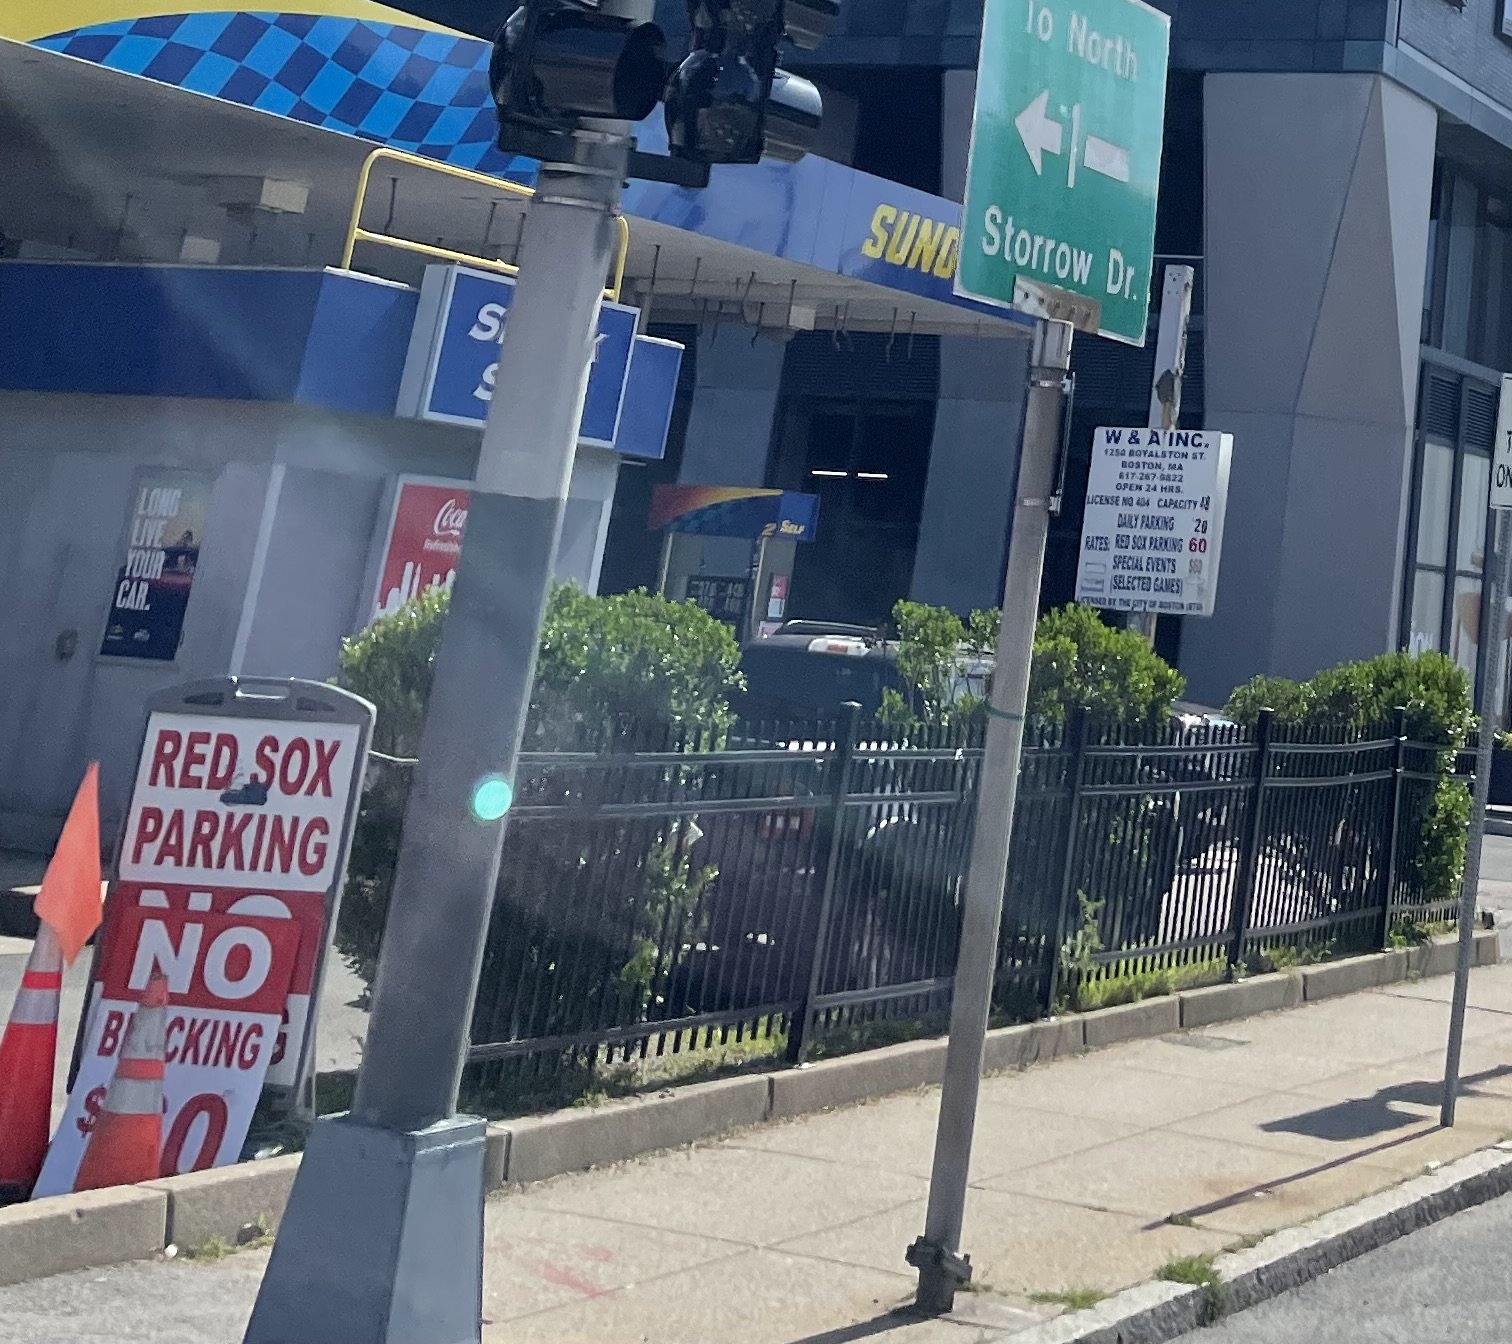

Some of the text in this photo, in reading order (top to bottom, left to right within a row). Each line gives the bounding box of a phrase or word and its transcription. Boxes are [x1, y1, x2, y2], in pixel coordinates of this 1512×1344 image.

[1067, 12, 1138, 81] North
[982, 205, 1137, 300] Storrow Dr.
[1105, 429, 1210, 449] W & A INC.
[1121, 460, 1183, 471] BOSTON, MA
[137, 487, 182, 517] LONG
[1087, 494, 1120, 506] LICENSE
[1157, 498, 1198, 510] CAPACITY
[1115, 482, 1143, 492] OPEN
[1145, 483, 1157, 493] 24
[131, 518, 168, 549] LIVE
[1117, 513, 1138, 529] DAILY
[1139, 515, 1175, 532] PARKING
[1084, 533, 1207, 553] RATES: RED SOX PARKING 60
[124, 548, 166, 580] YOUR
[1112, 554, 1144, 573] SPECIAL
[1145, 557, 1177, 574] EVENTS
[115, 579, 151, 611] CAR.
[1110, 574, 1184, 597] (SELECTED GAMES)
[149, 729, 341, 798] RED SOX
[131, 806, 330, 877] PARKING
[127, 918, 273, 1001] NO
[97, 1008, 264, 1070] BCKING
